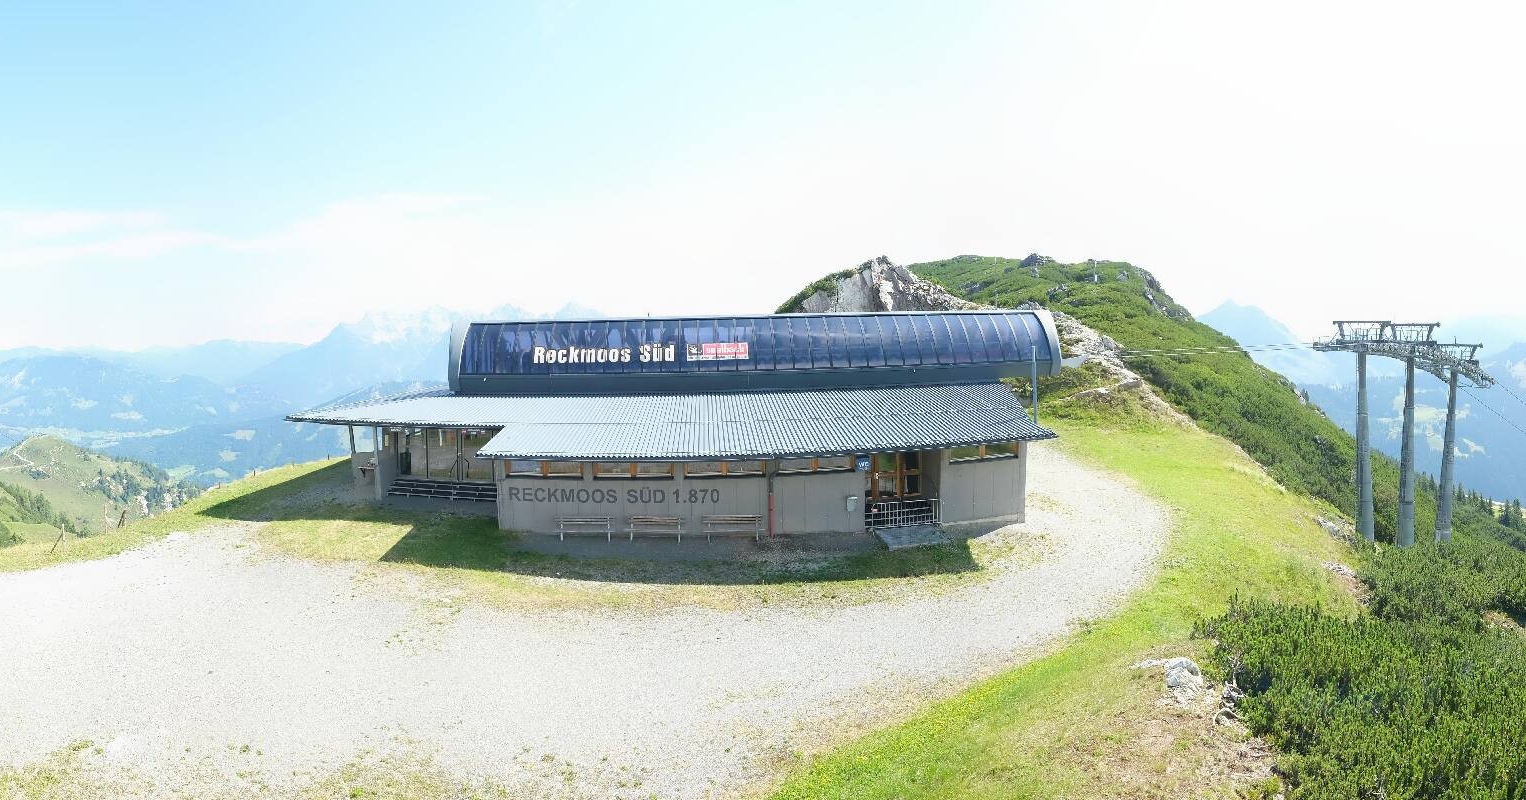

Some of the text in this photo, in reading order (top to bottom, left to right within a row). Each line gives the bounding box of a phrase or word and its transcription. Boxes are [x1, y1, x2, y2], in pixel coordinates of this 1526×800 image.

[533, 343, 675, 364] Reckmoos Süd
[508, 486, 720, 504] RECKMOOS SÜD 1.870
